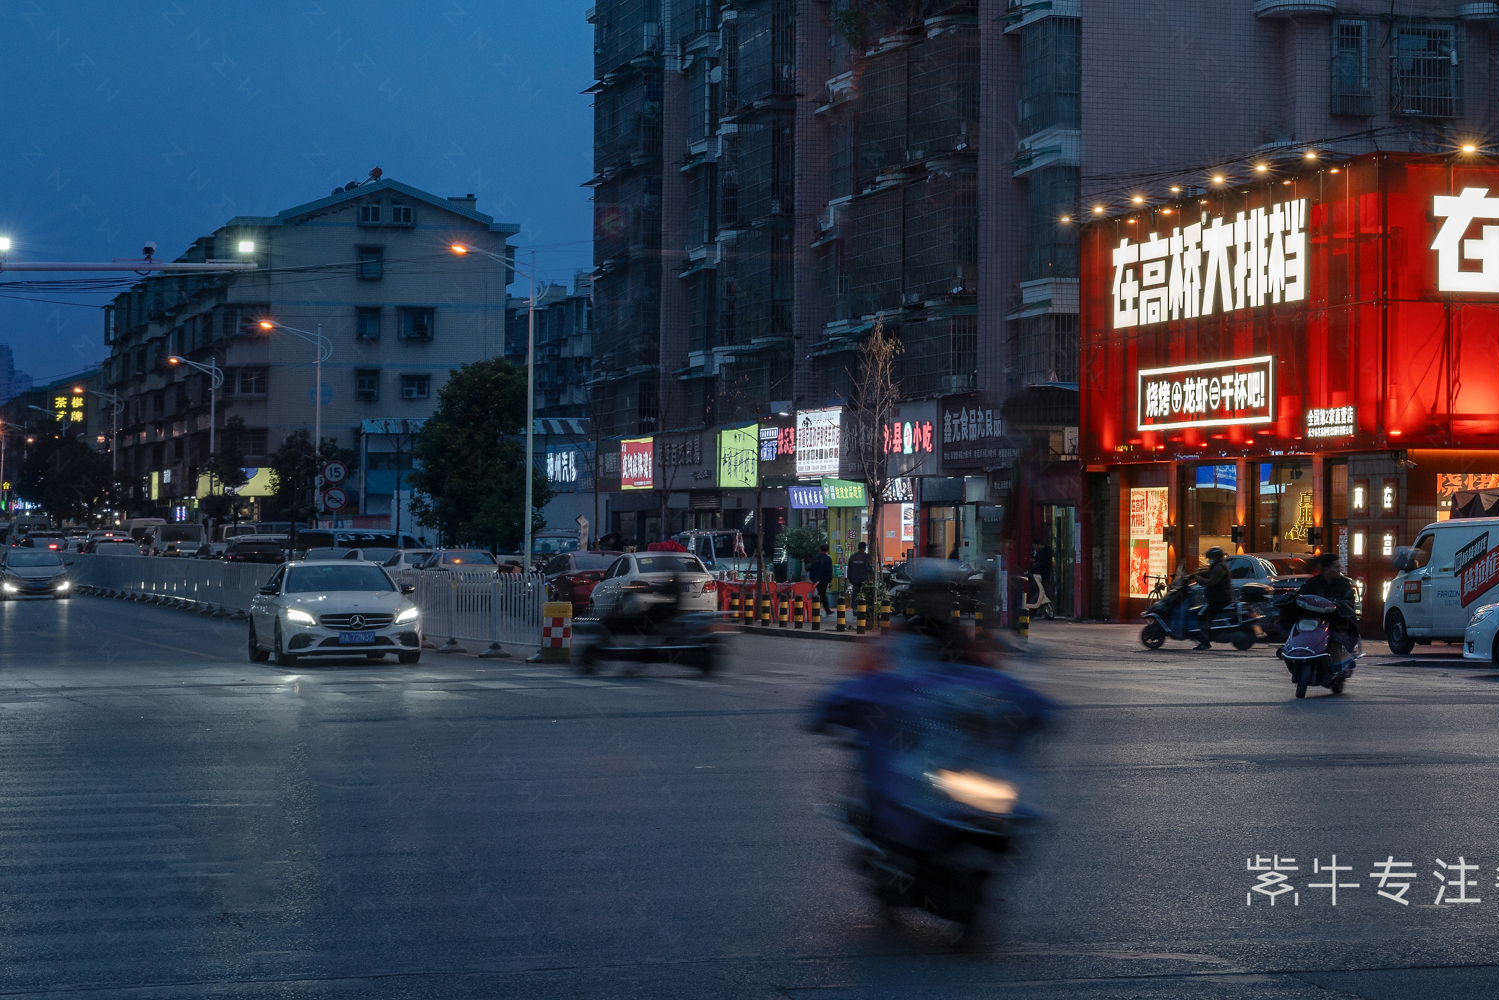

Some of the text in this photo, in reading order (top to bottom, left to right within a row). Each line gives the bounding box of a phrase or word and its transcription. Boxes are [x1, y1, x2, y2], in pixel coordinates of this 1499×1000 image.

[1112, 198, 1308, 329] 在高桥大排档
[1146, 370, 1266, 418] 烧烤 龙虾 干杯吧!
[1307, 405, 1354, 427] 全国第2家直营店
[913, 421, 933, 452] 小吃
[329, 467, 341, 477] 15
